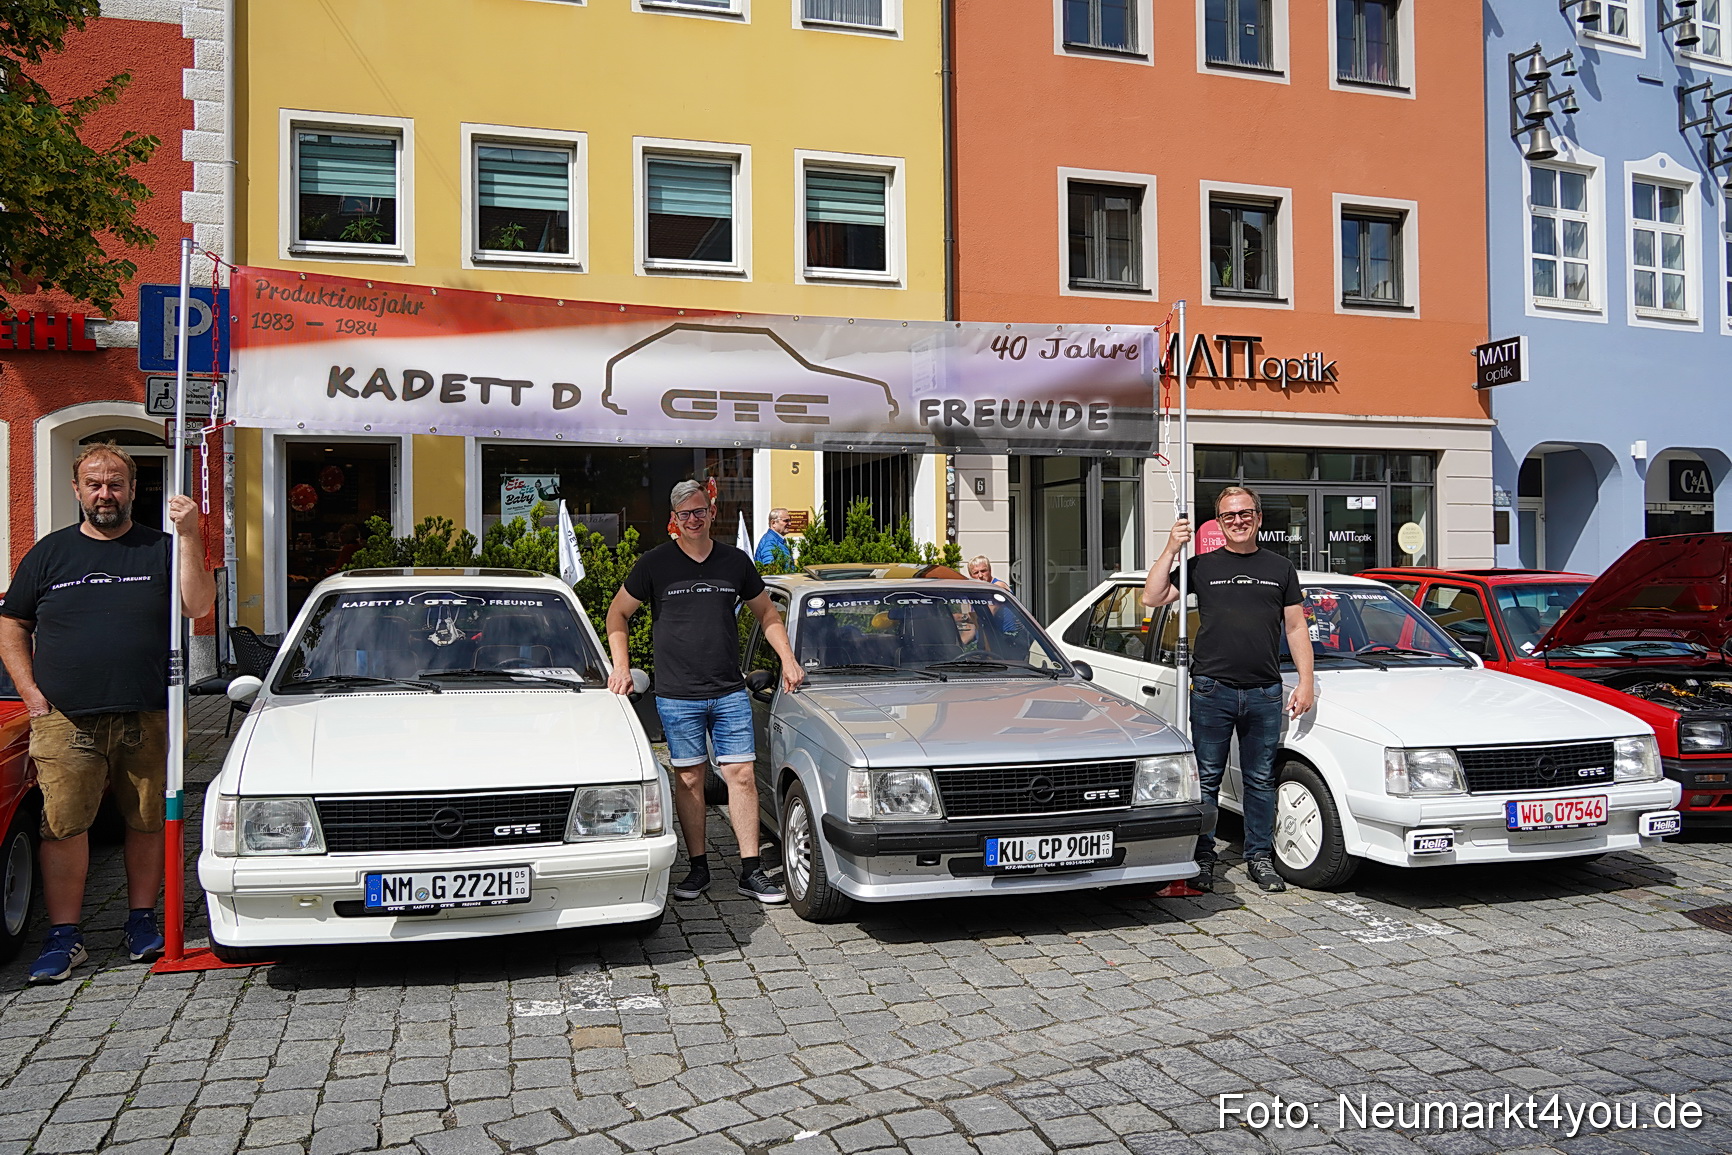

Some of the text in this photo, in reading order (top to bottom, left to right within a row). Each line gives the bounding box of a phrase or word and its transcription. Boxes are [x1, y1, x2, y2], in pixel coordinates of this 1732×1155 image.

[255, 279, 426, 318] Produktionsjahr
[164, 297, 212, 360] P
[252, 312, 294, 331] 1983
[335, 318, 378, 336] 1984
[990, 336, 1138, 360] 40 Jahre
[1480, 342, 1518, 366] MATT
[1486, 366, 1512, 383] optik
[327, 366, 1110, 430] KADETT D GTE FREUNDE
[792, 462, 800, 474] 5
[505, 479, 525, 491] Eis
[977, 480, 984, 491] 6
[1680, 469, 1711, 494] C&A
[505, 494, 535, 505] Baby
[1258, 531, 1302, 543] MATT optik
[1330, 531, 1372, 542] MATT optik
[1578, 767, 1605, 777] GTE
[1084, 789, 1120, 800] GTE
[1521, 804, 1543, 824] WÜ
[1555, 800, 1603, 822] 07546
[494, 823, 541, 836] GTE
[1653, 820, 1676, 831] Hella
[999, 840, 1024, 863] KU
[1038, 837, 1062, 860] CP
[1067, 835, 1101, 858] 90H
[1419, 839, 1448, 849] Hella
[382, 876, 412, 902] NM
[432, 876, 446, 899] G
[453, 872, 512, 898] 272H
